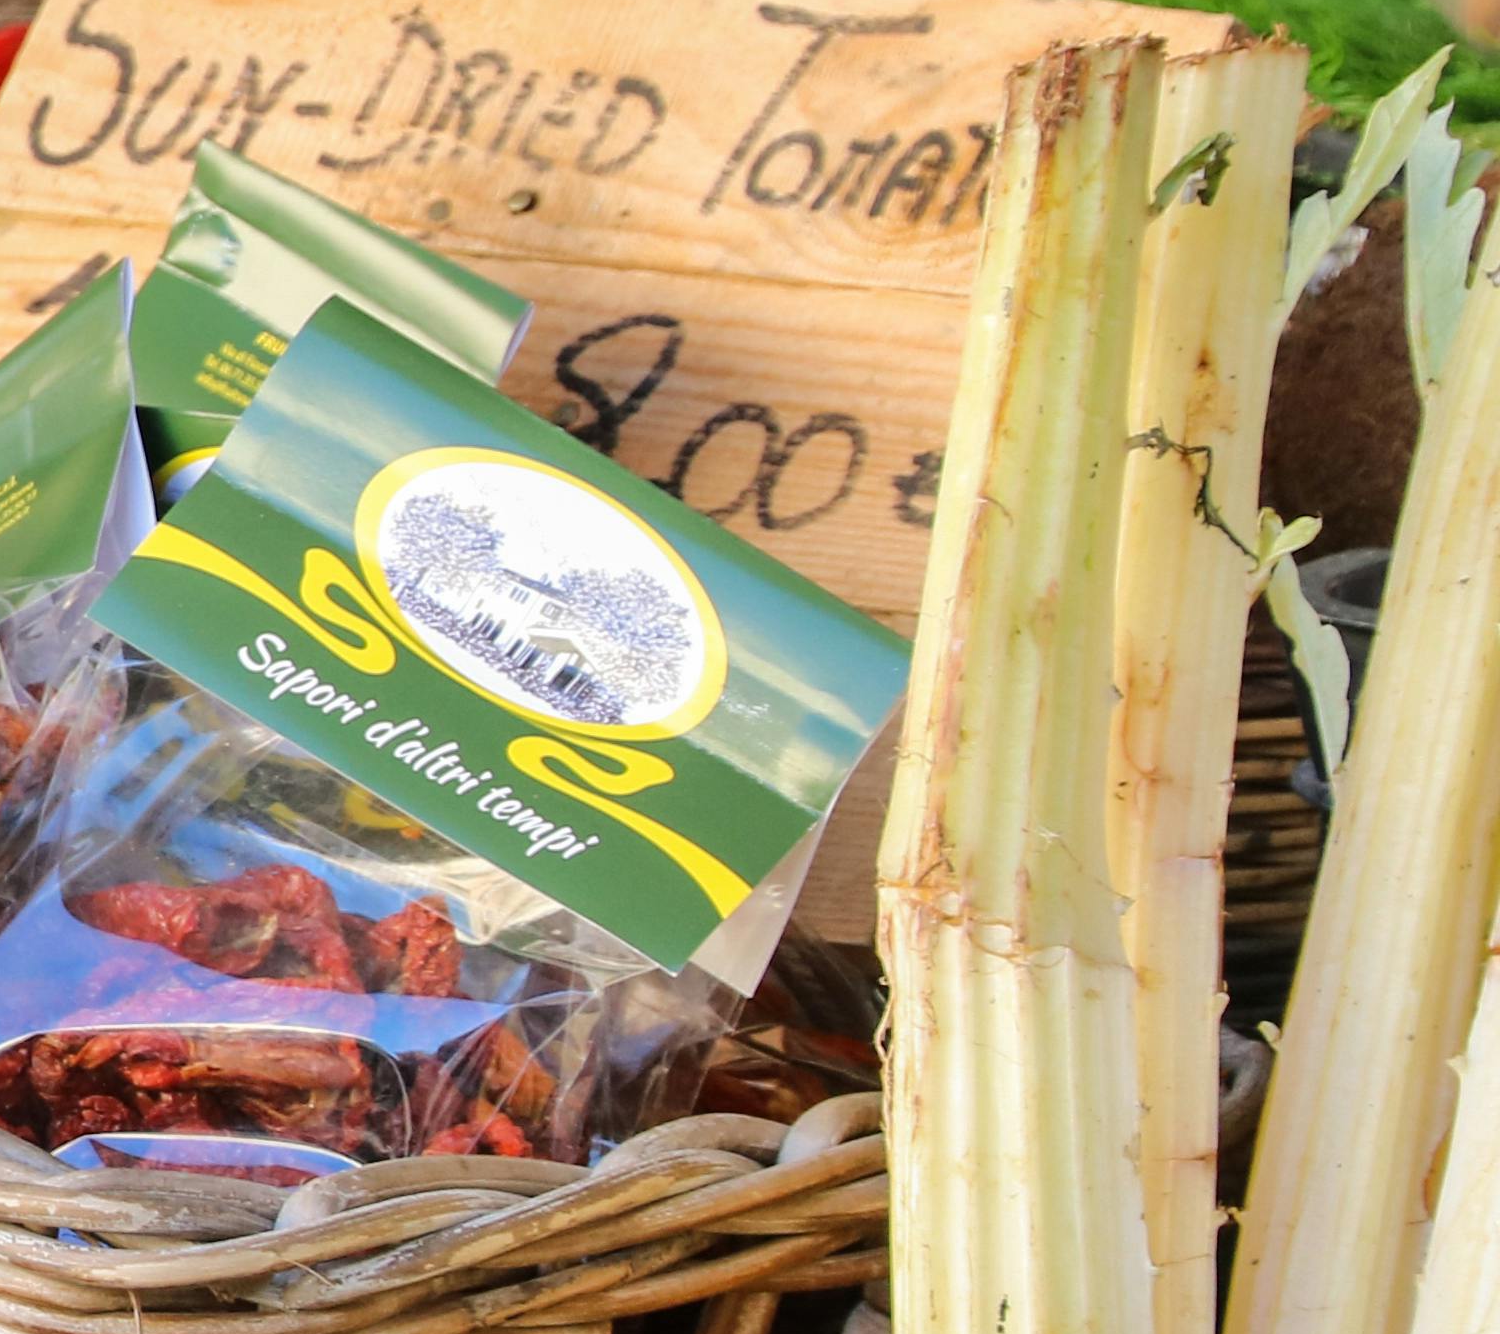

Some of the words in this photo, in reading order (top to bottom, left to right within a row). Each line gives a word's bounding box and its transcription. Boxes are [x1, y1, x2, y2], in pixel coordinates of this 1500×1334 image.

[700, 3, 995, 225] TOMAT
[237, 632, 378, 726] Sapori
[363, 716, 493, 797] d'altri
[476, 780, 600, 861] tempi
